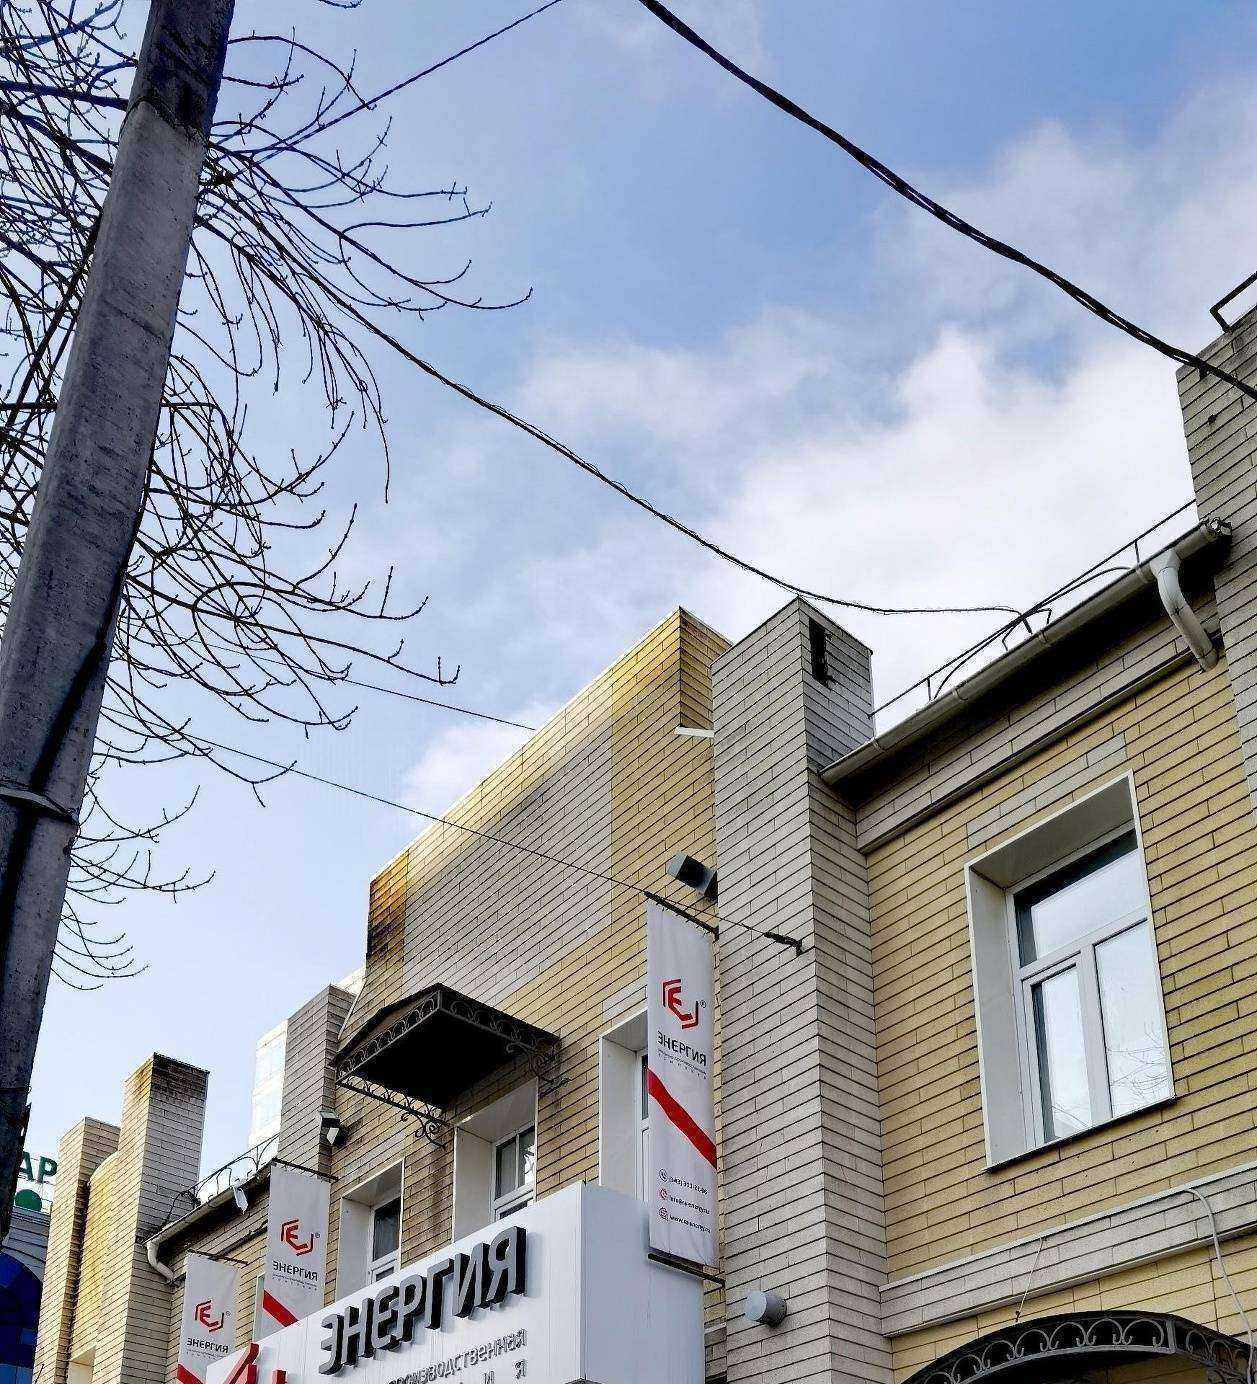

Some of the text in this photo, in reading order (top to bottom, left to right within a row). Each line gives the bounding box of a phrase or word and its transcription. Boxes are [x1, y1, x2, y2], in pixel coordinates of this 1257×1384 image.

[657, 1030, 706, 1067] ЭНЕРГИЯ
[273, 1260, 318, 1281] ЭНЕРГИЯ
[319, 1226, 526, 1376] ЭНЕРГИЯ
[186, 1337, 229, 1354] ЭНЕРГИЯ
